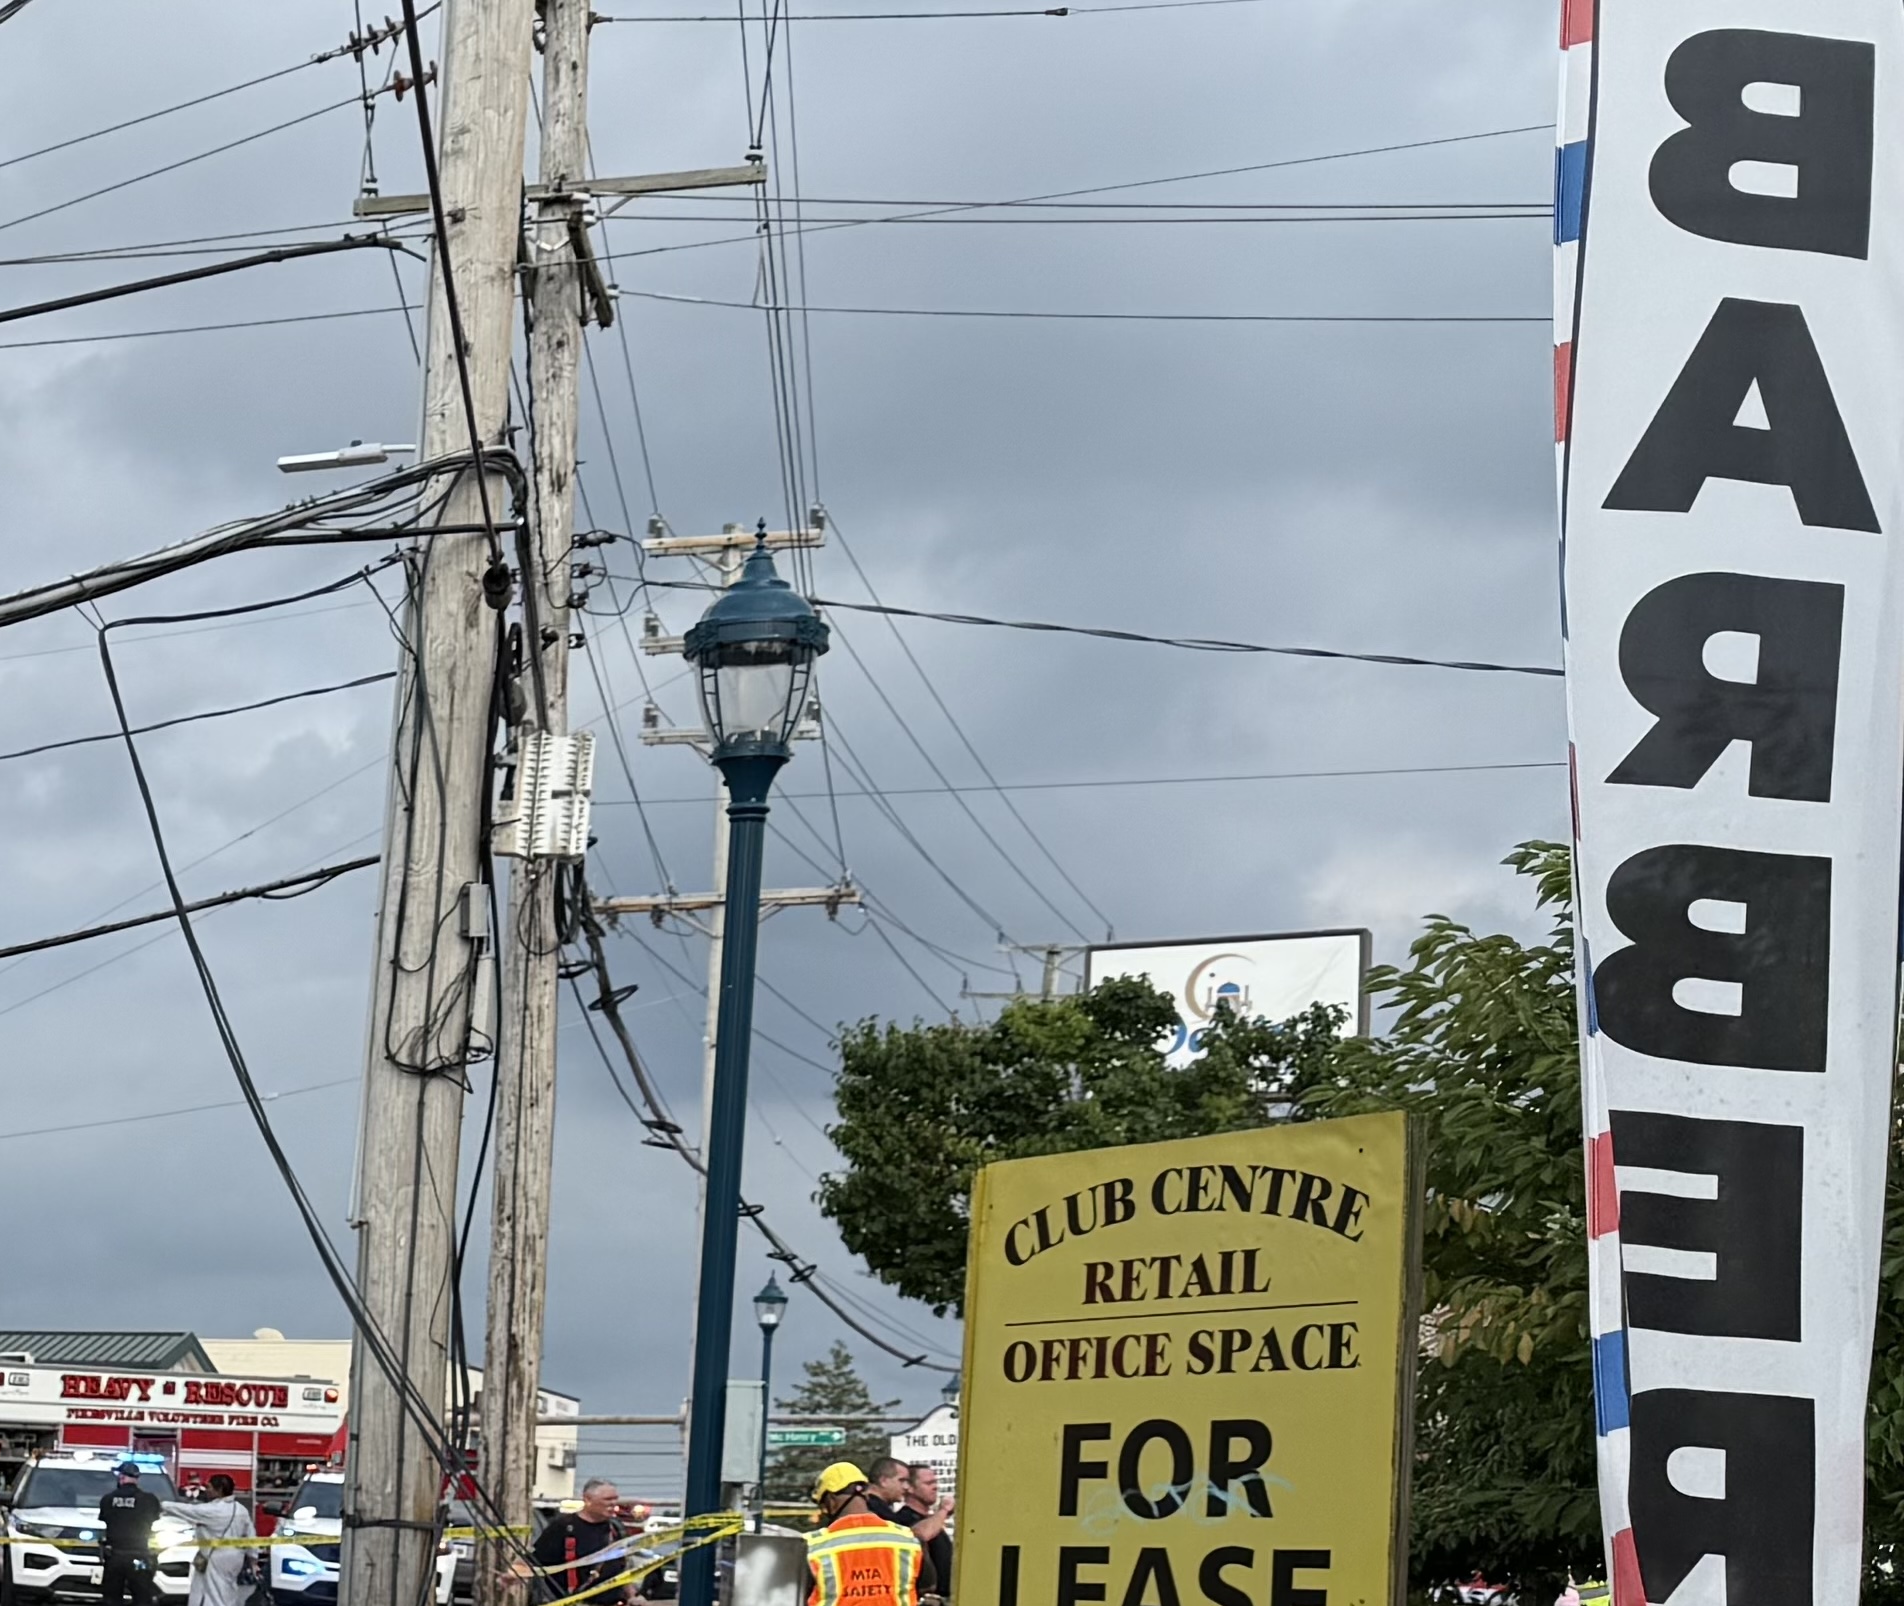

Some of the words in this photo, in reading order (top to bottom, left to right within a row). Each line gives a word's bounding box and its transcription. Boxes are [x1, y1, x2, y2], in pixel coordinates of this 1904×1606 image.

[1002, 1177, 1136, 1267] CLUB
[1151, 1164, 1371, 1243] CENTRE
[1081, 1248, 1272, 1305] RETAIL
[1002, 1332, 1173, 1384] OFFICE
[1185, 1322, 1360, 1376] SPACE
[60, 1374, 155, 1402] HEAVY
[184, 1381, 289, 1408] RESCUE
[905, 1435, 928, 1446] THE
[932, 1434, 957, 1446] OLD
[1058, 1418, 1274, 1520] FOR
[112, 1496, 135, 1508] POLICE
[841, 1584, 891, 1597] SAFETY
[851, 1568, 881, 1580] MTA
